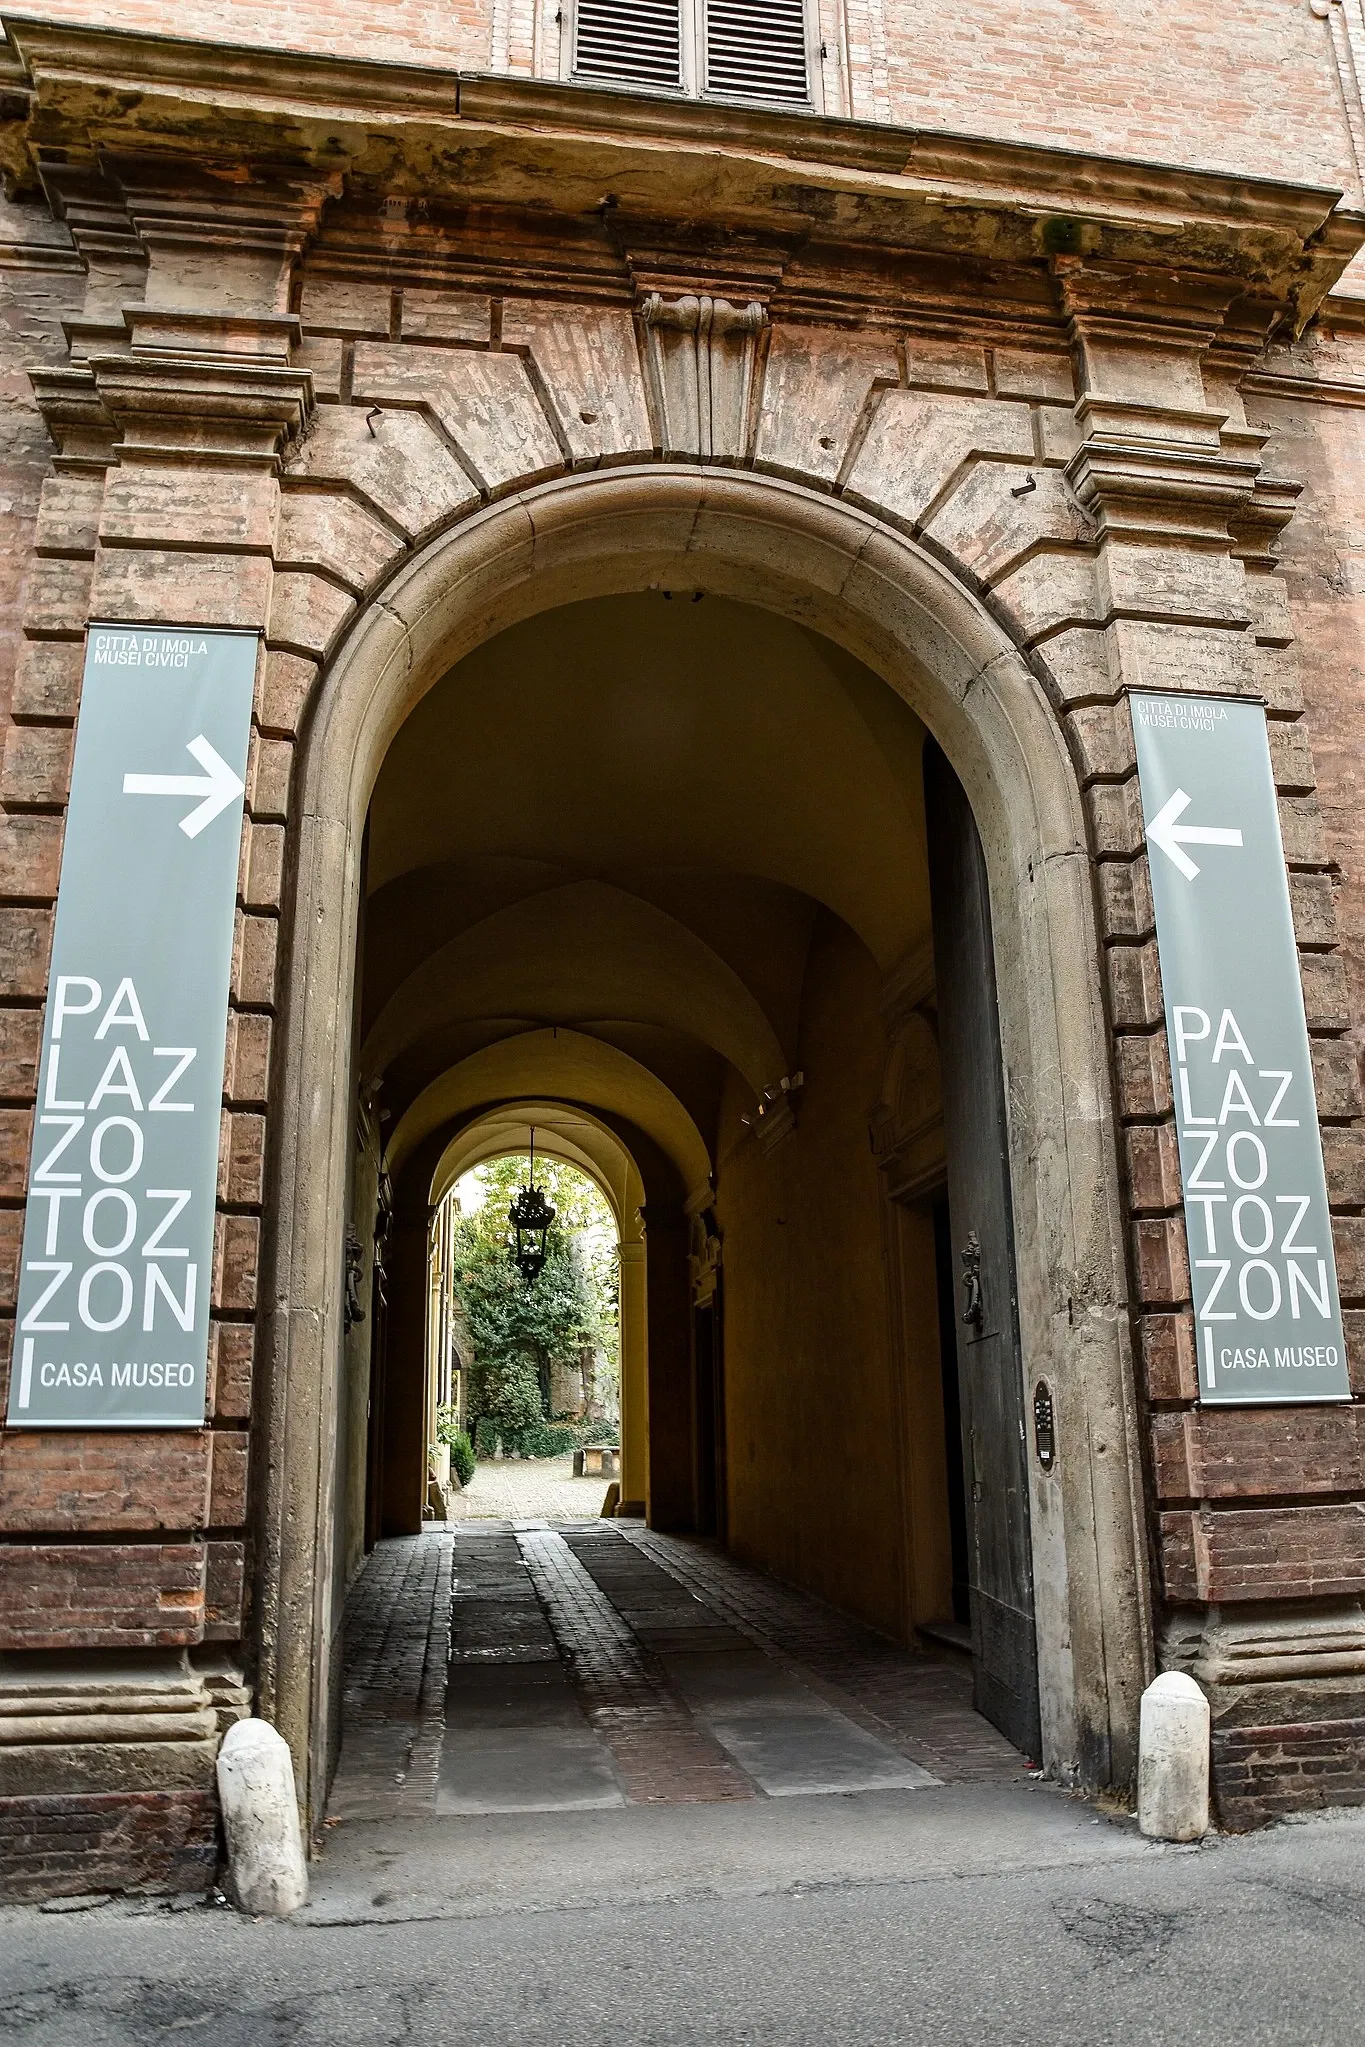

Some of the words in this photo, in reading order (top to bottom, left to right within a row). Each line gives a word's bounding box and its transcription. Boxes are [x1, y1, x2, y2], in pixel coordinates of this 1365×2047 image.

[94, 650, 141, 665] MUSEI
[145, 652, 189, 667] CIVICI
[95, 634, 139, 650] CITTÀ
[142, 638, 157, 652] DI
[161, 639, 208, 654] IMOLA
[1137, 700, 1173, 716] CITTÀ
[1175, 704, 1187, 716] DI
[1190, 705, 1228, 720] IMOLA
[1139, 714, 1177, 728] MUSEI
[1180, 717, 1215, 731] CIVICI
[51, 975, 150, 1041] PA
[1172, 1005, 1255, 1065] PA
[44, 1044, 197, 1112] LAZ
[1179, 1067, 1300, 1127] LAZ
[33, 1115, 144, 1183] ZO
[1182, 1130, 1268, 1190] ZO
[29, 1187, 192, 1257] TOZ
[1185, 1194, 1317, 1255] TOZ
[20, 1261, 198, 1332] ZON
[1194, 1258, 1332, 1321] ZON
[18, 1337, 35, 1408] I
[40, 1363, 103, 1387] CASA
[111, 1363, 195, 1387] MUSEO
[1204, 1326, 1216, 1389] I
[1220, 1347, 1270, 1369] CASA
[1274, 1346, 1338, 1368] MUSEO
